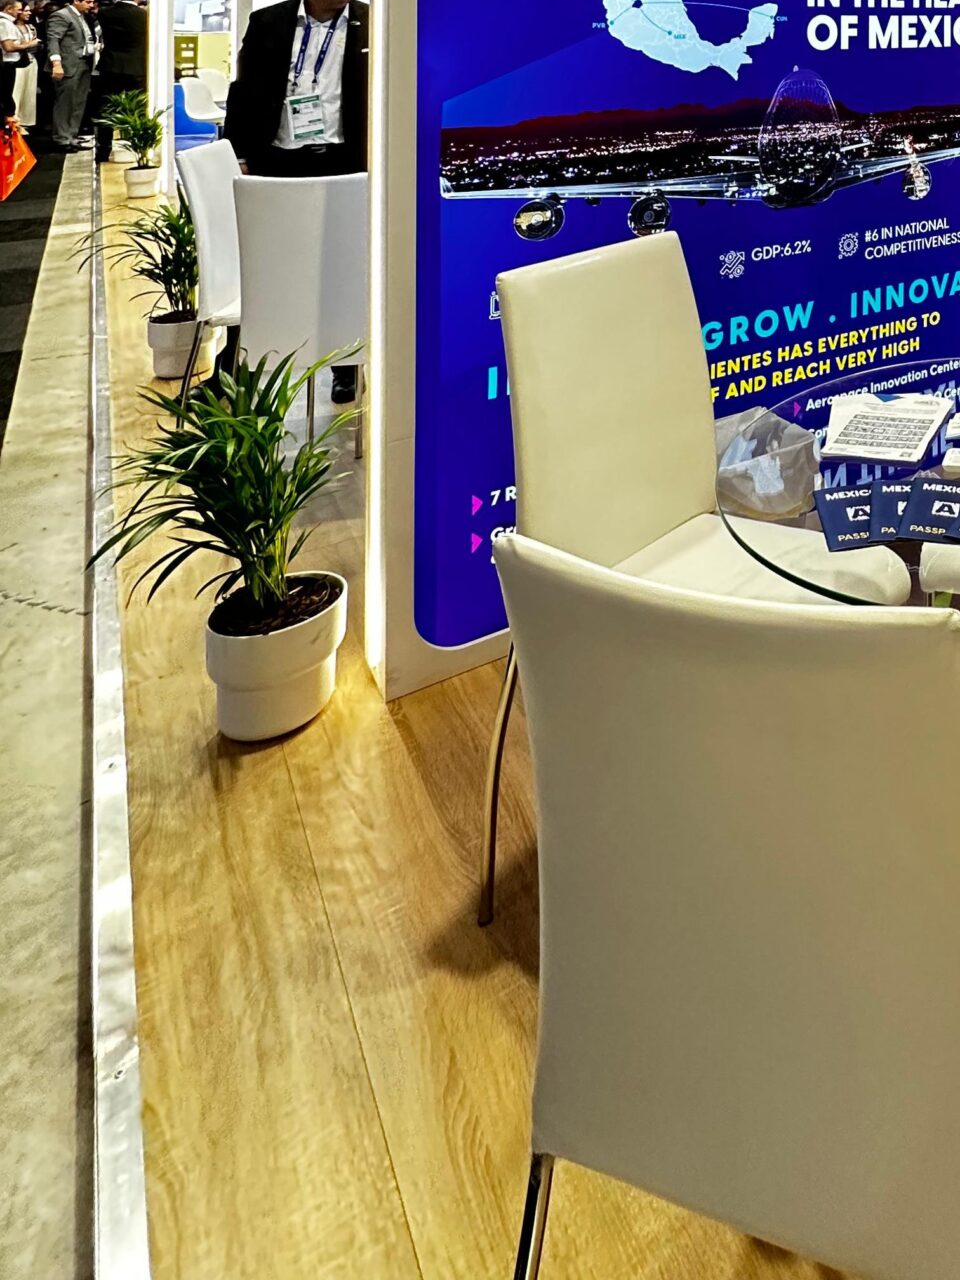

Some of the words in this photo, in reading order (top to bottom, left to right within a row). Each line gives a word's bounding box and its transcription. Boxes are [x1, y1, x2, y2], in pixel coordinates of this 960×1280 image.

[807, 14, 859, 51] OF
[864, 230, 879, 242] #6
[881, 227, 893, 239] IN
[895, 218, 950, 236] NATIONAL
[751, 240, 812, 261] GDP:6.2%
[701, 301, 815, 350] GROW
[711, 350, 772, 380] IENTES
[777, 340, 813, 363] HAS
[818, 317, 917, 352] EVERYTHING
[921, 311, 941, 328] TO
[725, 375, 767, 399] AND
[772, 359, 831, 386] REACH
[835, 348, 877, 370] VERY
[882, 337, 921, 360] HIGH
[870, 370, 928, 393] Innovation
[490, 490, 500, 506] 7
[825, 489, 871, 502] MEXIC
[881, 485, 911, 493] MEX
[837, 531, 870, 542] PASS
[910, 524, 946, 535] PASSP
